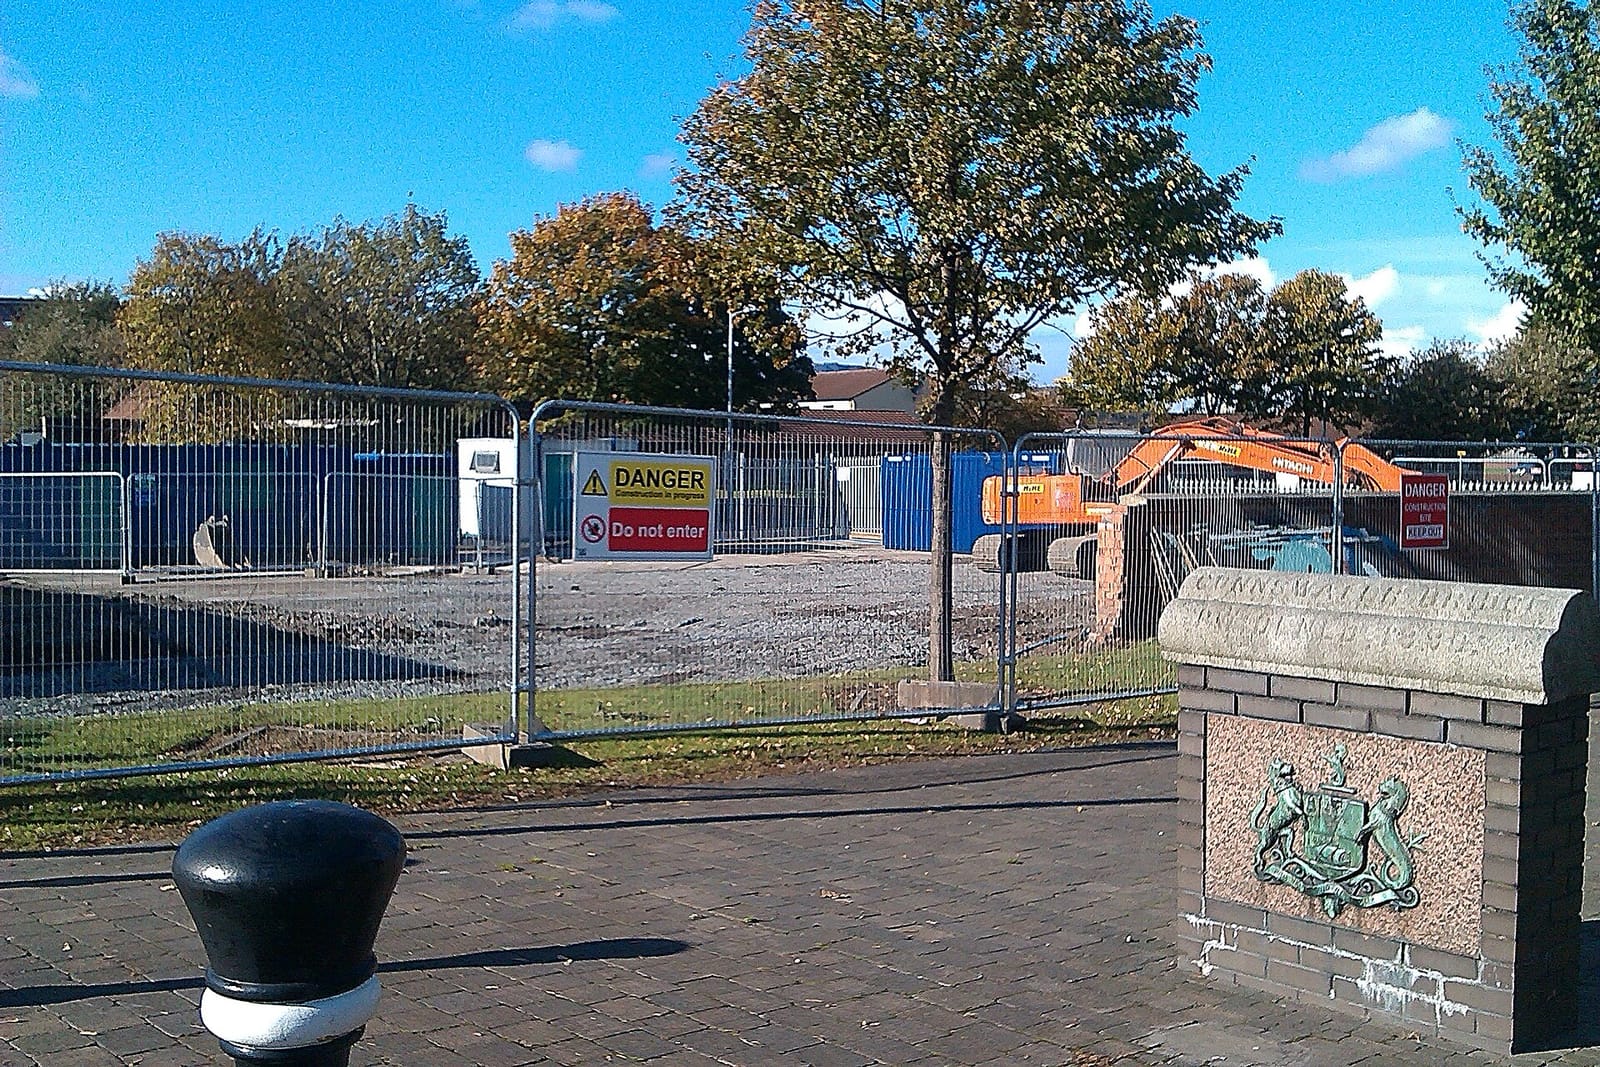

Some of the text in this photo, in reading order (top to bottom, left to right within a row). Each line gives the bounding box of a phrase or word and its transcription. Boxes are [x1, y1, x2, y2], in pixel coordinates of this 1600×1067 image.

[1272, 456, 1314, 474] HITACHI
[615, 468, 704, 489] DANGER
[615, 489, 705, 501] Construction in progress
[1405, 483, 1446, 497] DANGER
[1404, 502, 1446, 513] CONSTRUCTION
[612, 522, 705, 539] Do not enter
